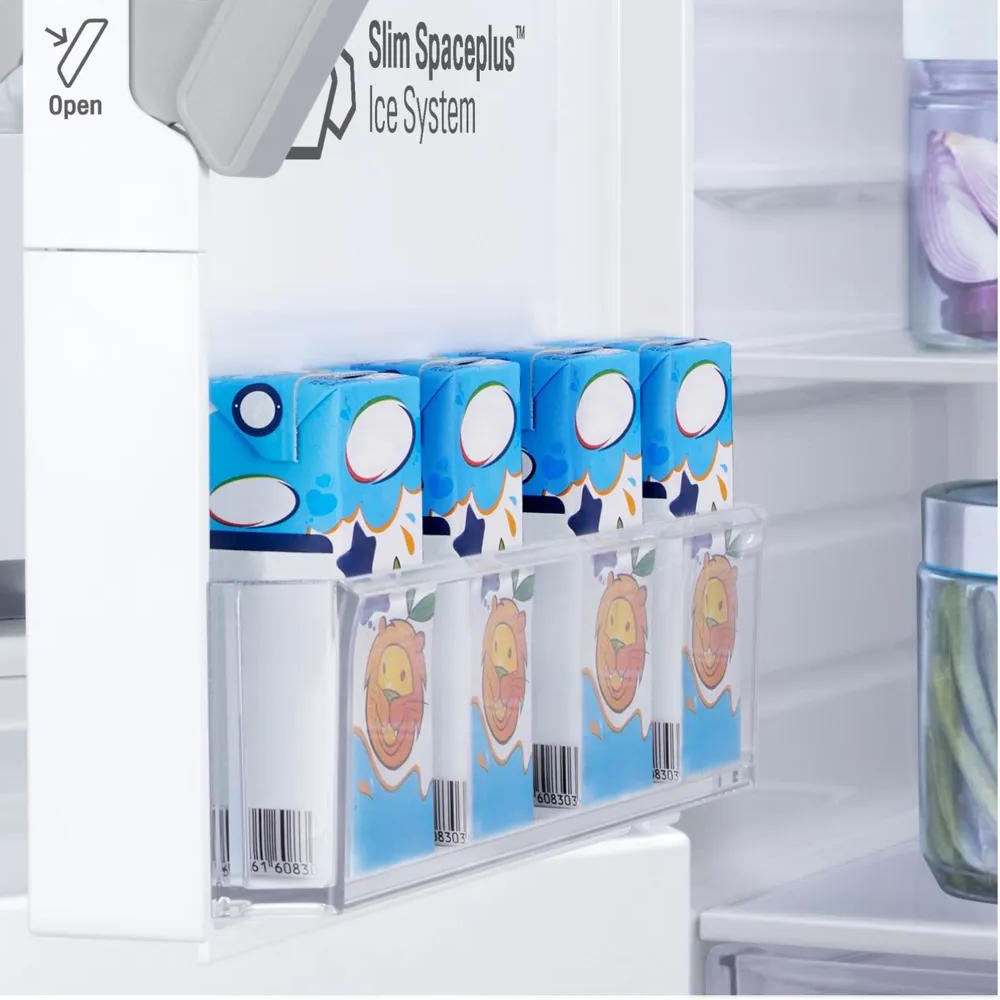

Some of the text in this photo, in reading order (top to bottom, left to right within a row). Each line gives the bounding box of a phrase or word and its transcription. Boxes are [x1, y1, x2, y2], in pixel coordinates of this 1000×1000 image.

[368, 20, 410, 69] Slim
[49, 94, 102, 119] Open
[369, 85, 476, 145] Ice System
[652, 769, 679, 781] 8303
